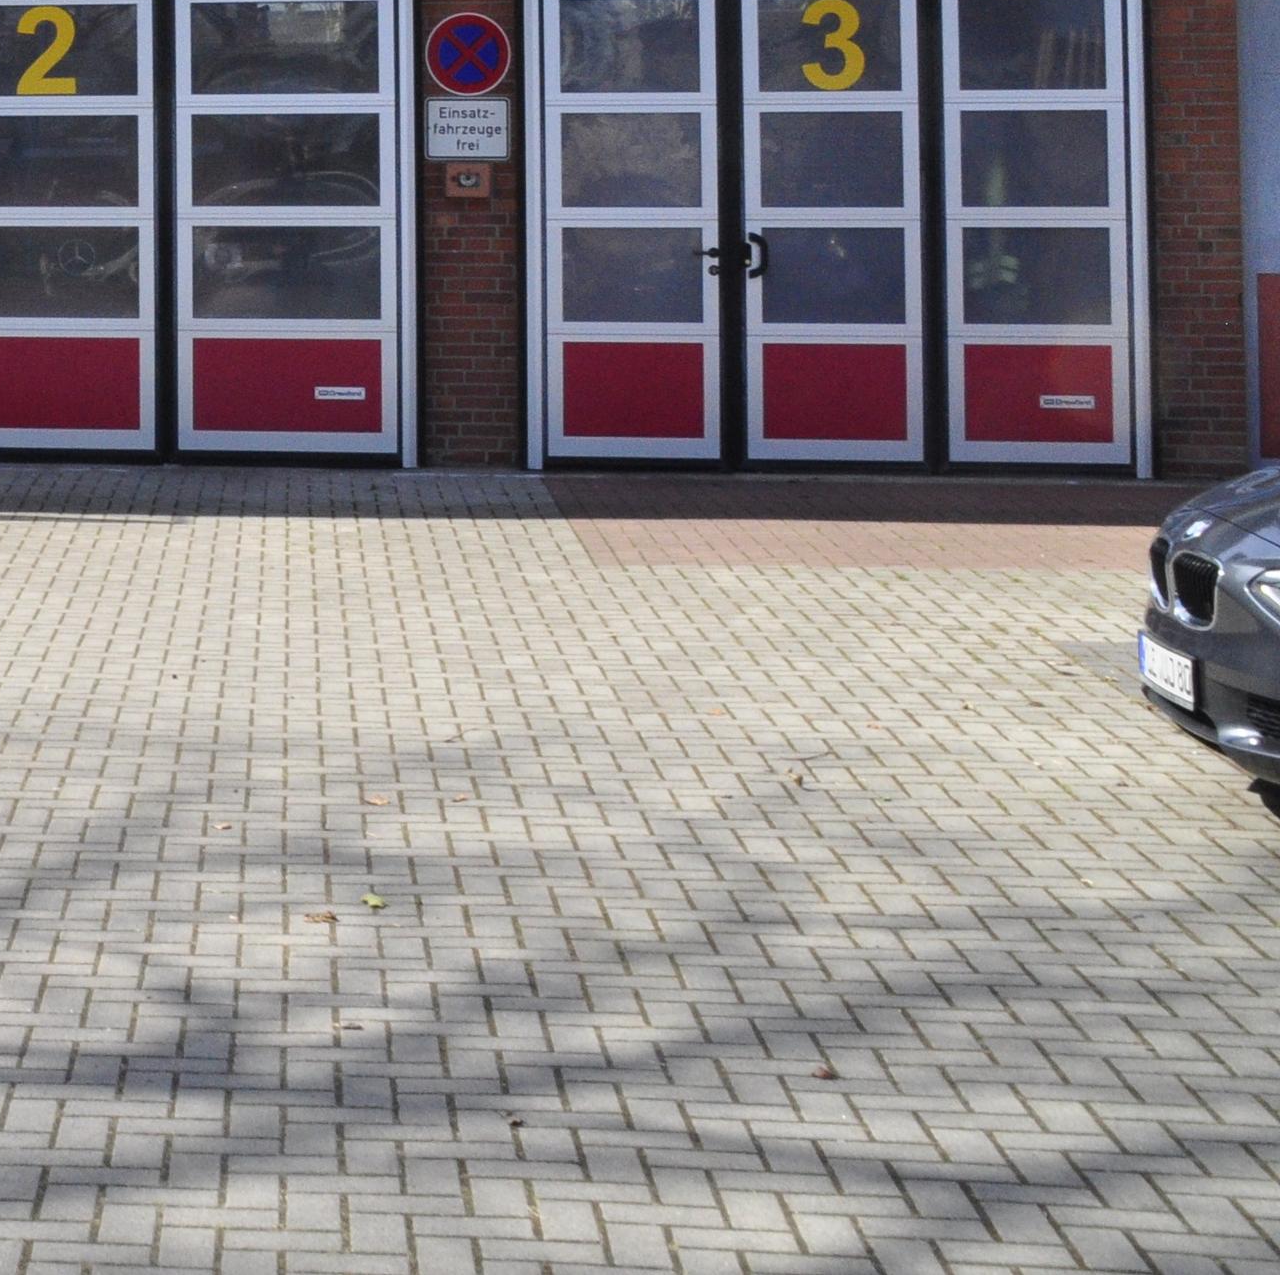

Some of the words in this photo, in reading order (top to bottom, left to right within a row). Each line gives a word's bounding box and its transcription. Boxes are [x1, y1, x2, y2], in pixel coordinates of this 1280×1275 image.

[16, 5, 77, 96] 2
[438, 106, 496, 119] Einsatz-
[433, 123, 503, 138] fahrzeuge
[456, 138, 480, 151] frei
